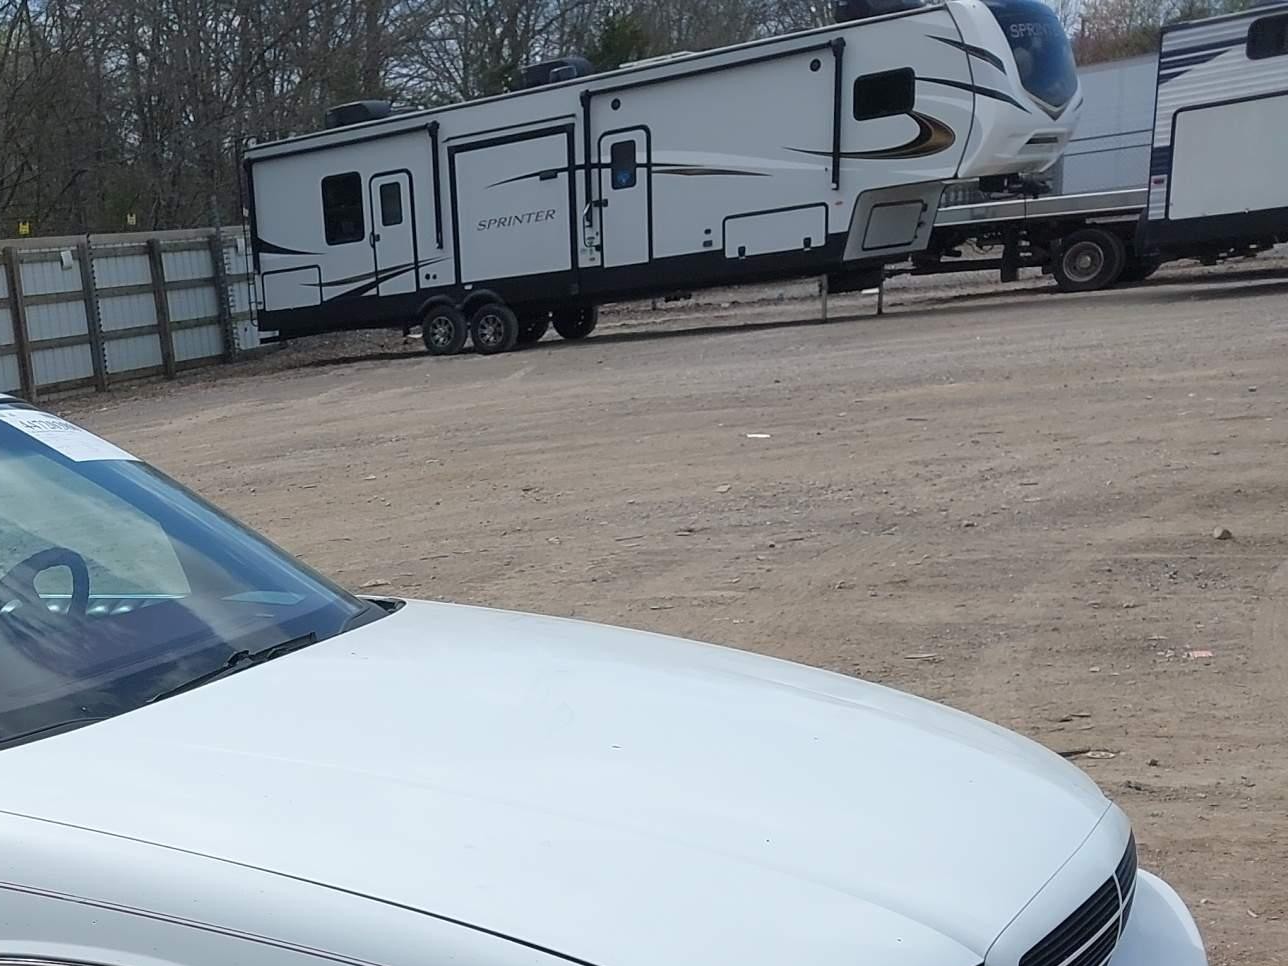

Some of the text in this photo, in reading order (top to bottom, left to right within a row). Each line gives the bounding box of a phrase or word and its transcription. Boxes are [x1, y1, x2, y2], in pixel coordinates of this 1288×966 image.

[1010, 22, 1060, 38] SPRIN
[477, 209, 556, 231] SPRINTER
[19, 420, 82, 433] 4472
